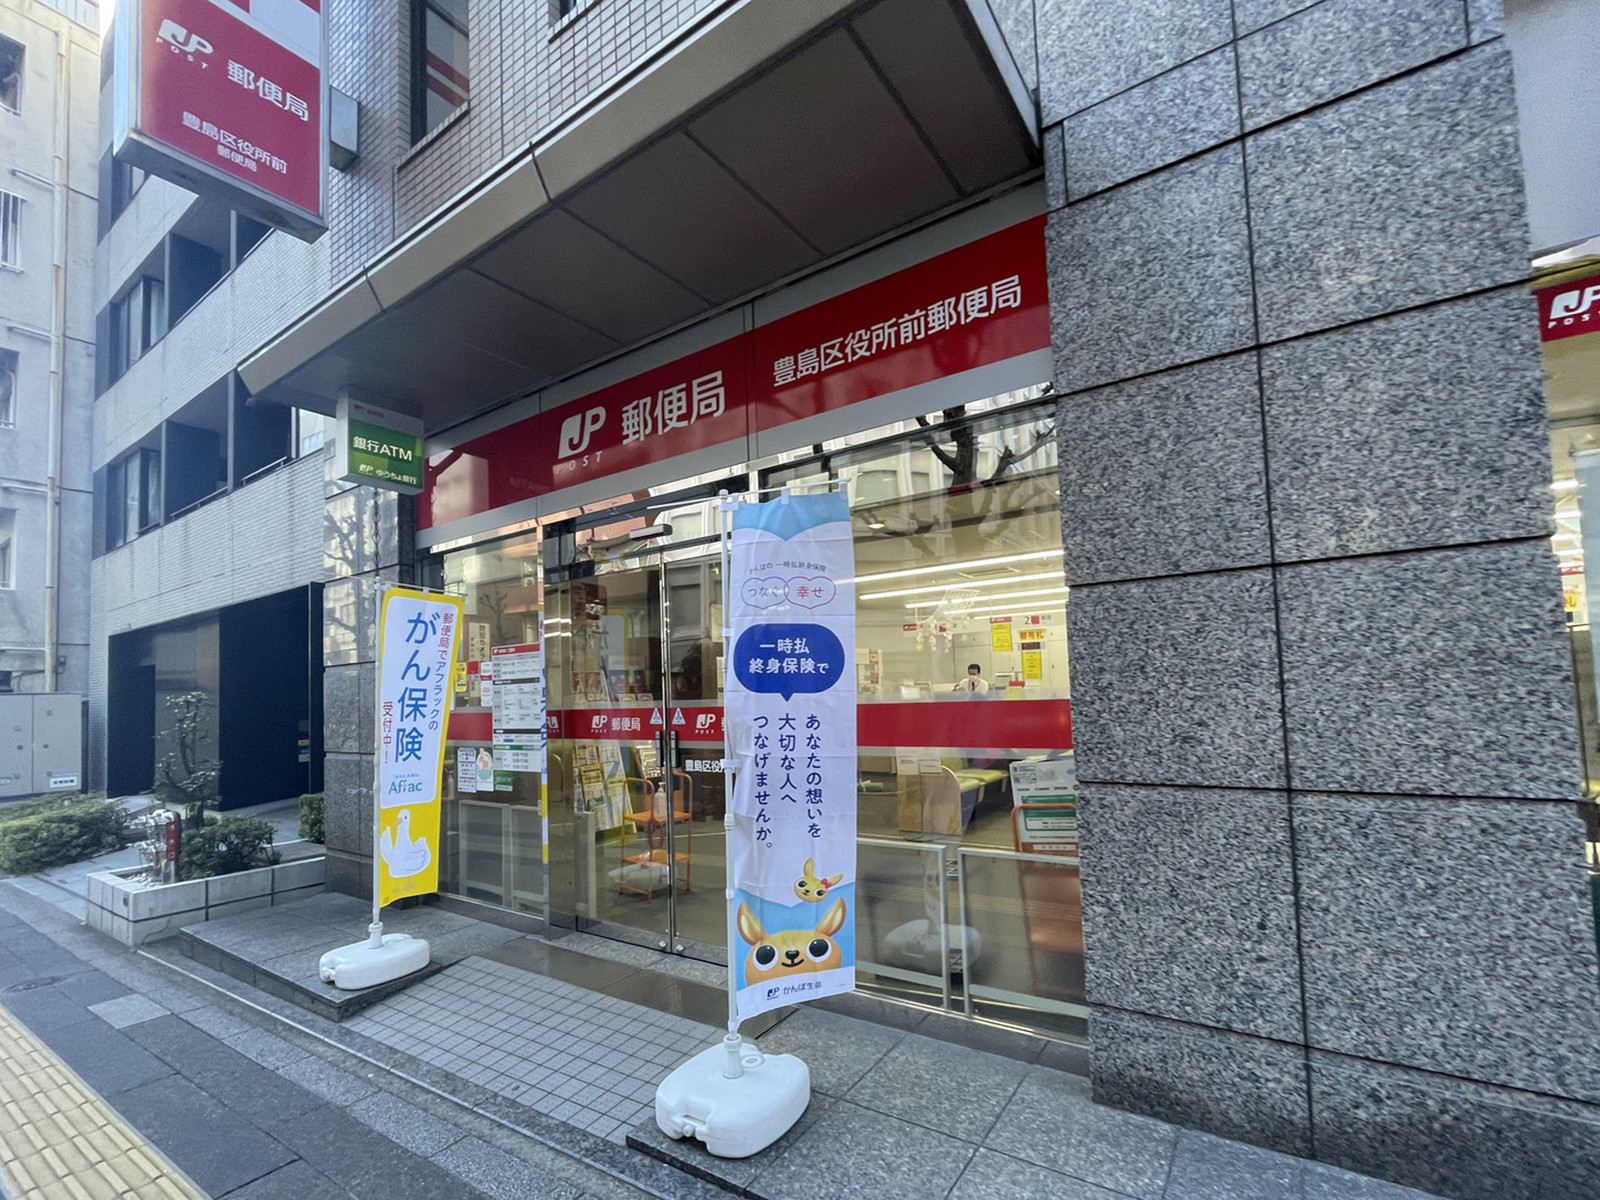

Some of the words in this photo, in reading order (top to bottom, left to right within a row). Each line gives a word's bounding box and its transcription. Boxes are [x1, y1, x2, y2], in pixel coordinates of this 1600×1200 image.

[156, 37, 208, 69] POST
[227, 59, 309, 122] 郵便局
[183, 111, 288, 174] 豊島区役所前
[217, 145, 257, 172] 郵便局
[773, 275, 1022, 387] 豊島区役所前郵便局
[1548, 311, 1600, 329] POS
[621, 370, 726, 445] 郵便局
[353, 436, 412, 461] 銀行ATM
[554, 451, 602, 474] POST
[376, 469, 417, 484] ゆうちょ銀行
[748, 586, 778, 598] つなぐ
[796, 586, 824, 599] 幸せ
[759, 638, 810, 654] 一時払
[428, 612, 454, 731] 郵便局でアフラックの
[749, 658, 829, 674] 終身保険で
[395, 612, 440, 763] がん保険
[612, 717, 641, 731] 郵便局
[778, 713, 797, 803] 大切な人へ
[388, 779, 423, 796] Aflac
[753, 715, 773, 848] つなげませんか。
[806, 714, 823, 838] あなたの想いを
[783, 982, 822, 995] かんぽ生命
